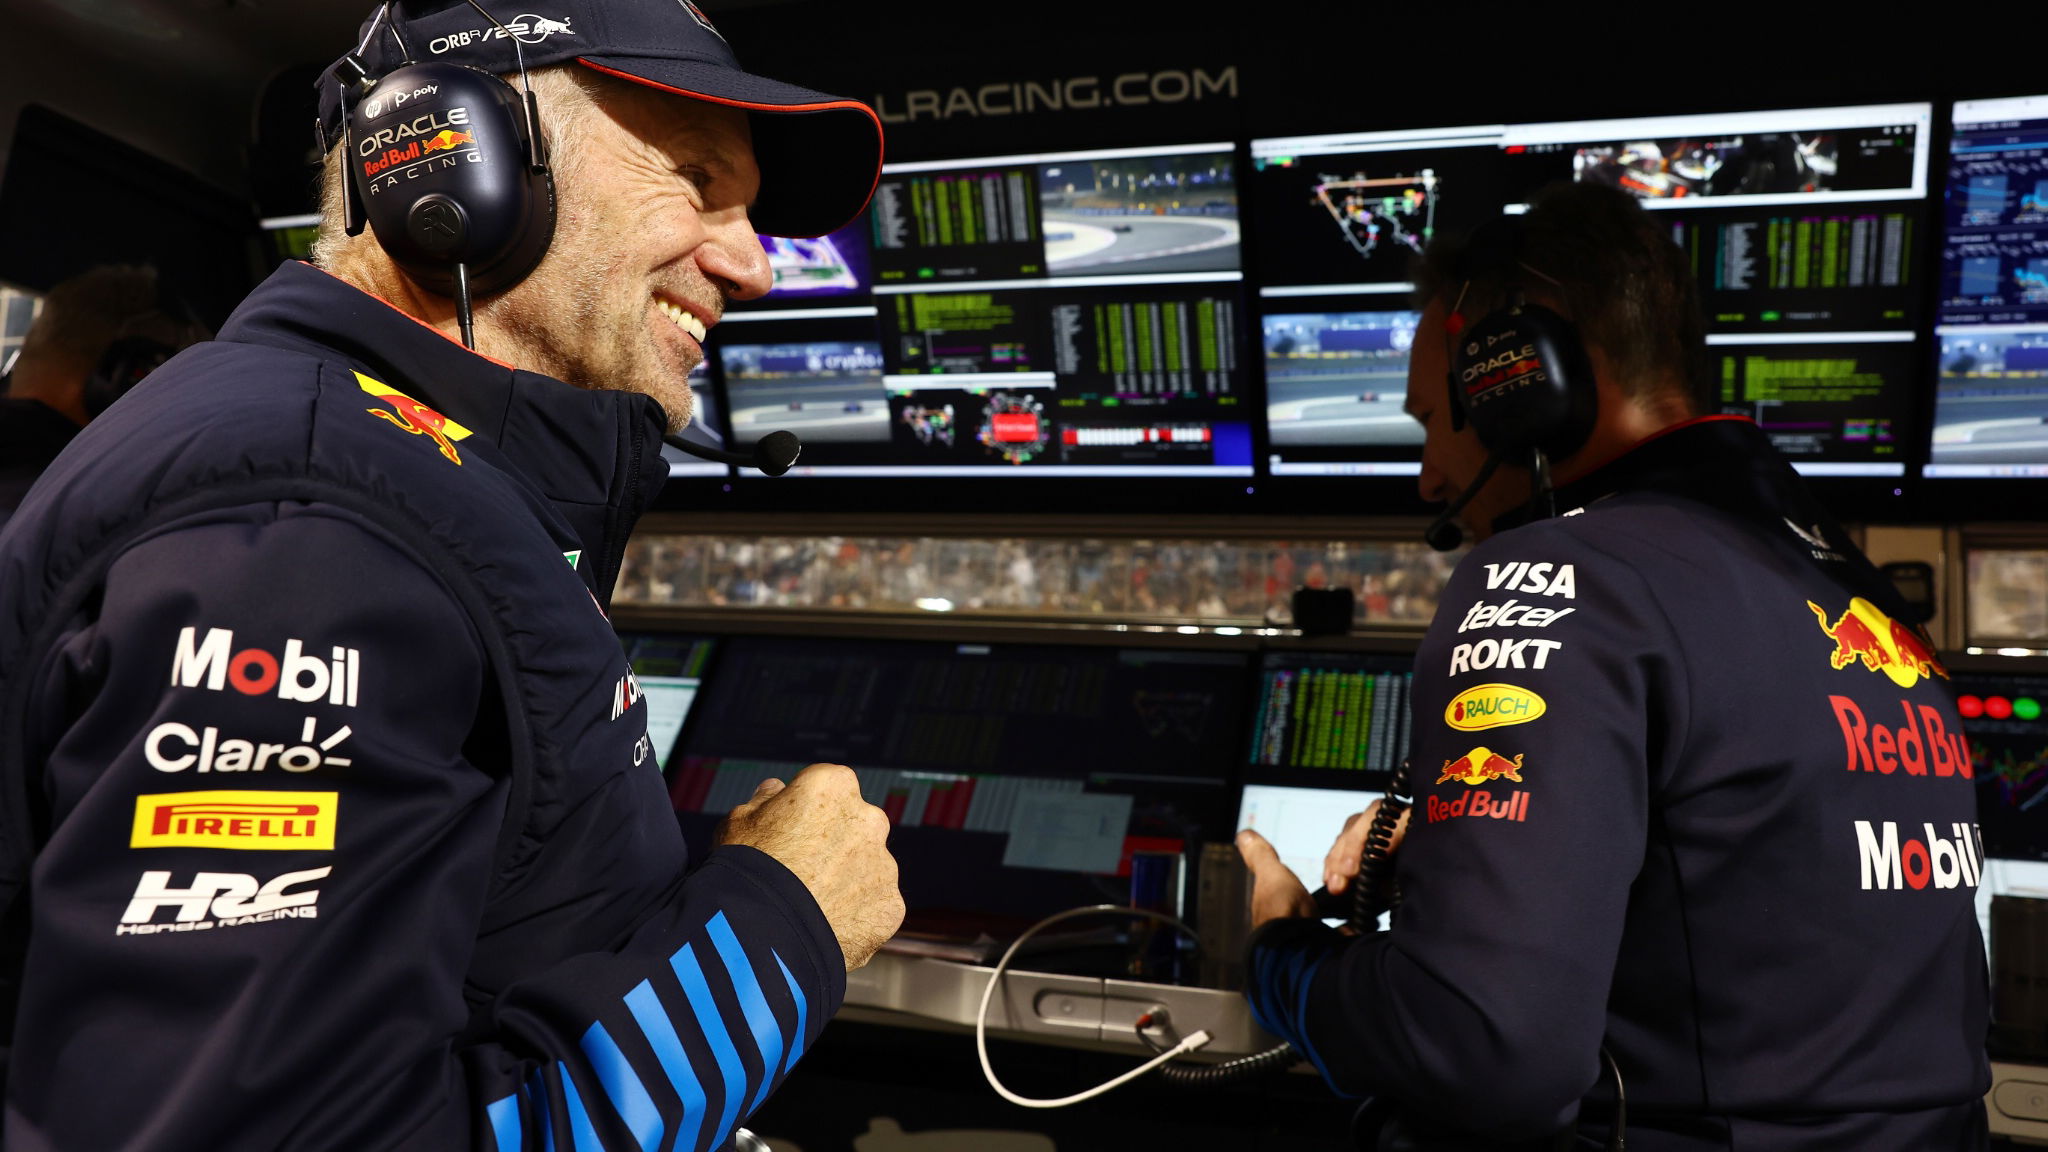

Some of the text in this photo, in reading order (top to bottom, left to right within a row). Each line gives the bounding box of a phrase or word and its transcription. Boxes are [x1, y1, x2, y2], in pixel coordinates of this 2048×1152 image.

[413, 85, 438, 99] poly
[360, 107, 469, 157] ORACLE
[364, 142, 420, 177] Red Bull
[370, 151, 482, 195] RACING
[1463, 344, 1536, 382] ORACLE
[1483, 562, 1576, 599] VISA
[171, 626, 359, 707] Mobil
[1449, 638, 1562, 677] ROKT
[1466, 697, 1530, 719] RAUCH
[145, 721, 321, 773] Claro
[1828, 695, 1927, 775] Red
[151, 804, 320, 837] PIRELLI
[1427, 790, 1530, 823] Red Bull
[1854, 821, 1980, 890] Mobil
[120, 866, 332, 923] HRC
[116, 906, 317, 936] Honda RACING
